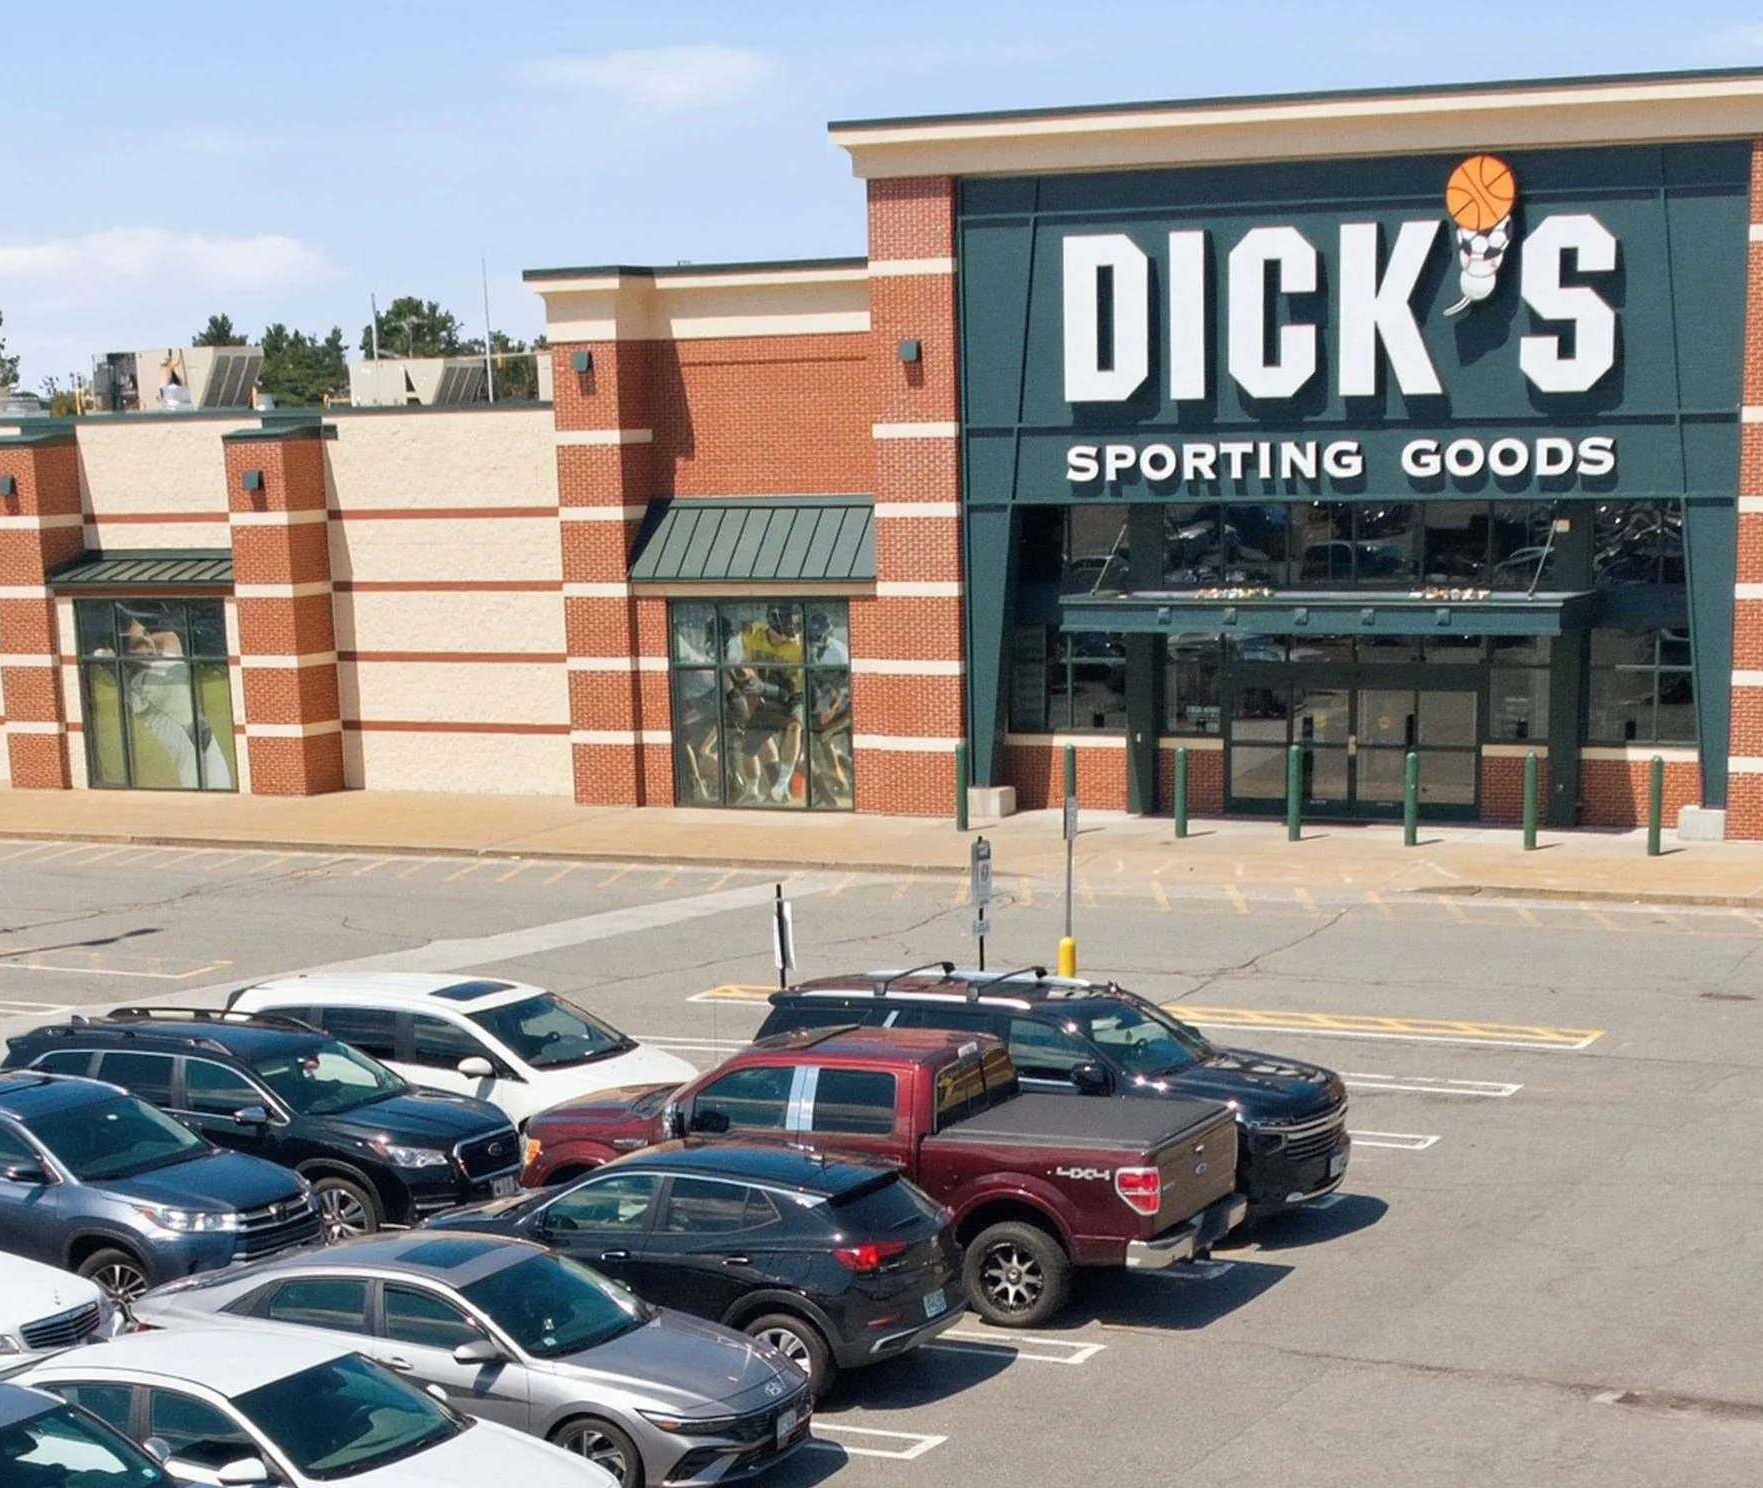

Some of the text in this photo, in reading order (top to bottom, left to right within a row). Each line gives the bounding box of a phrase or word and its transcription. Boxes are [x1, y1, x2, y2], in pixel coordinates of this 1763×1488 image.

[1062, 155, 1617, 402] DICK'S
[1066, 437, 1616, 482] SPORTING GOODS
